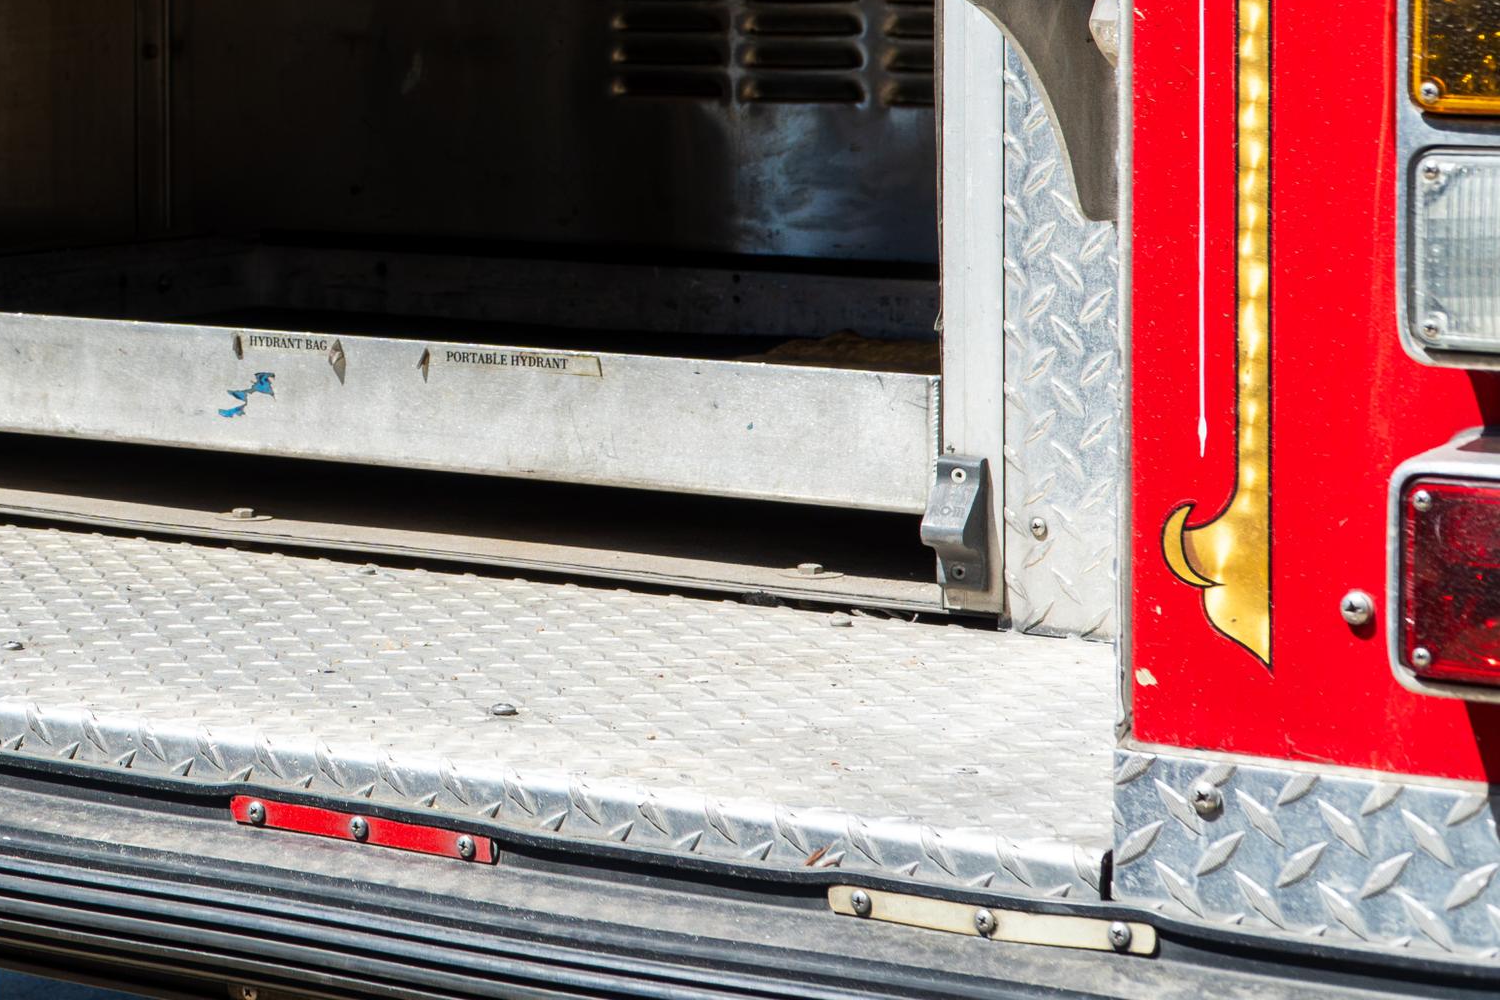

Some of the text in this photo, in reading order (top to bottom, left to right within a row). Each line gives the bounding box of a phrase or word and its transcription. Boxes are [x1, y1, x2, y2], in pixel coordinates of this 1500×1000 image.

[250, 335, 328, 351] HYDRANT BAG
[446, 351, 569, 370] PORTABLE HYDRANT
